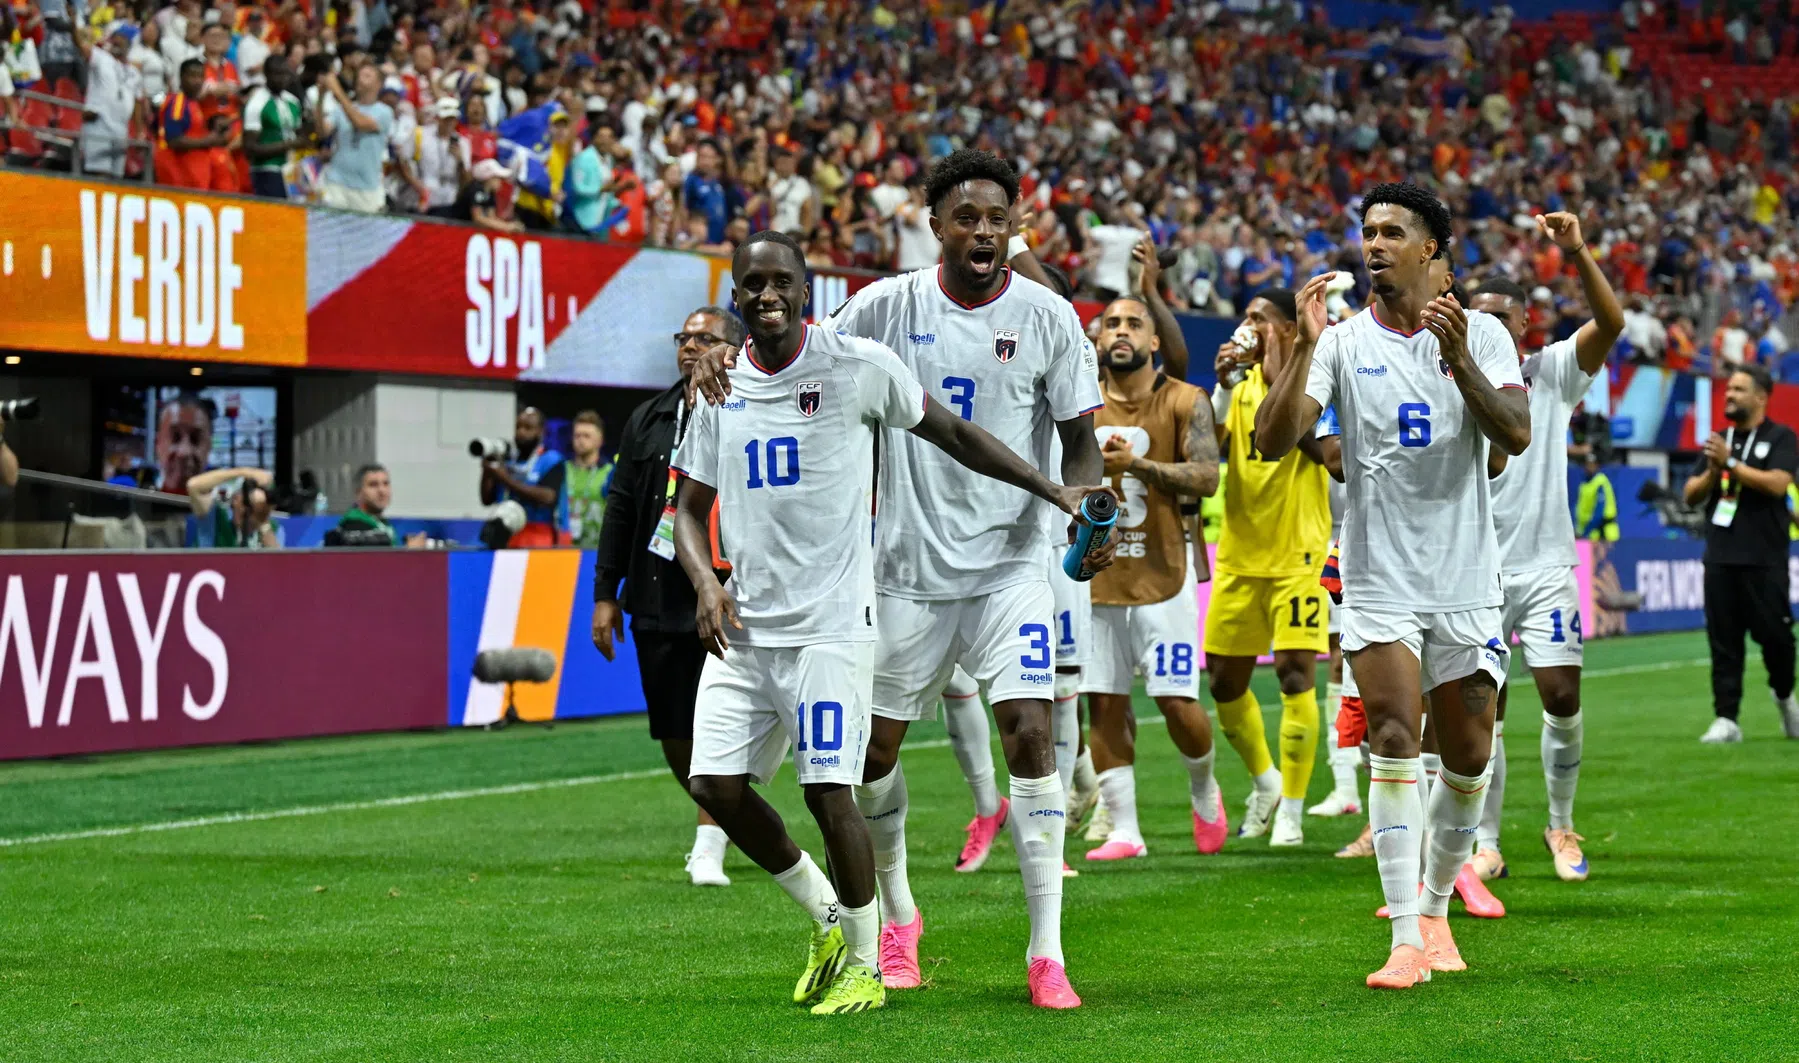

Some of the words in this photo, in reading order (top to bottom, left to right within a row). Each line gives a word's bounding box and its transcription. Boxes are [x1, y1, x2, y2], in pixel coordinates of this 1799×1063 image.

[80, 190, 245, 350] VERDE
[465, 234, 546, 369] SPA
[996, 330, 1018, 338] FCF
[1356, 365, 1388, 375] capelli
[721, 399, 746, 410] capelli
[942, 376, 976, 422] 3
[1398, 402, 1432, 448] 6
[744, 436, 801, 490] 10
[1247, 430, 1281, 462] 1
[1116, 542, 1147, 558] 26
[1123, 532, 1147, 542] CUP
[1053, 610, 1075, 646] 1
[1289, 596, 1320, 628] 12
[1549, 609, 1583, 645] 14
[0, 569, 229, 729] WAYS
[1018, 623, 1051, 670] 3
[1155, 643, 1193, 677] 18
[1020, 672, 1053, 683] capelli
[798, 701, 844, 752] 10
[810, 755, 841, 767] capelli
